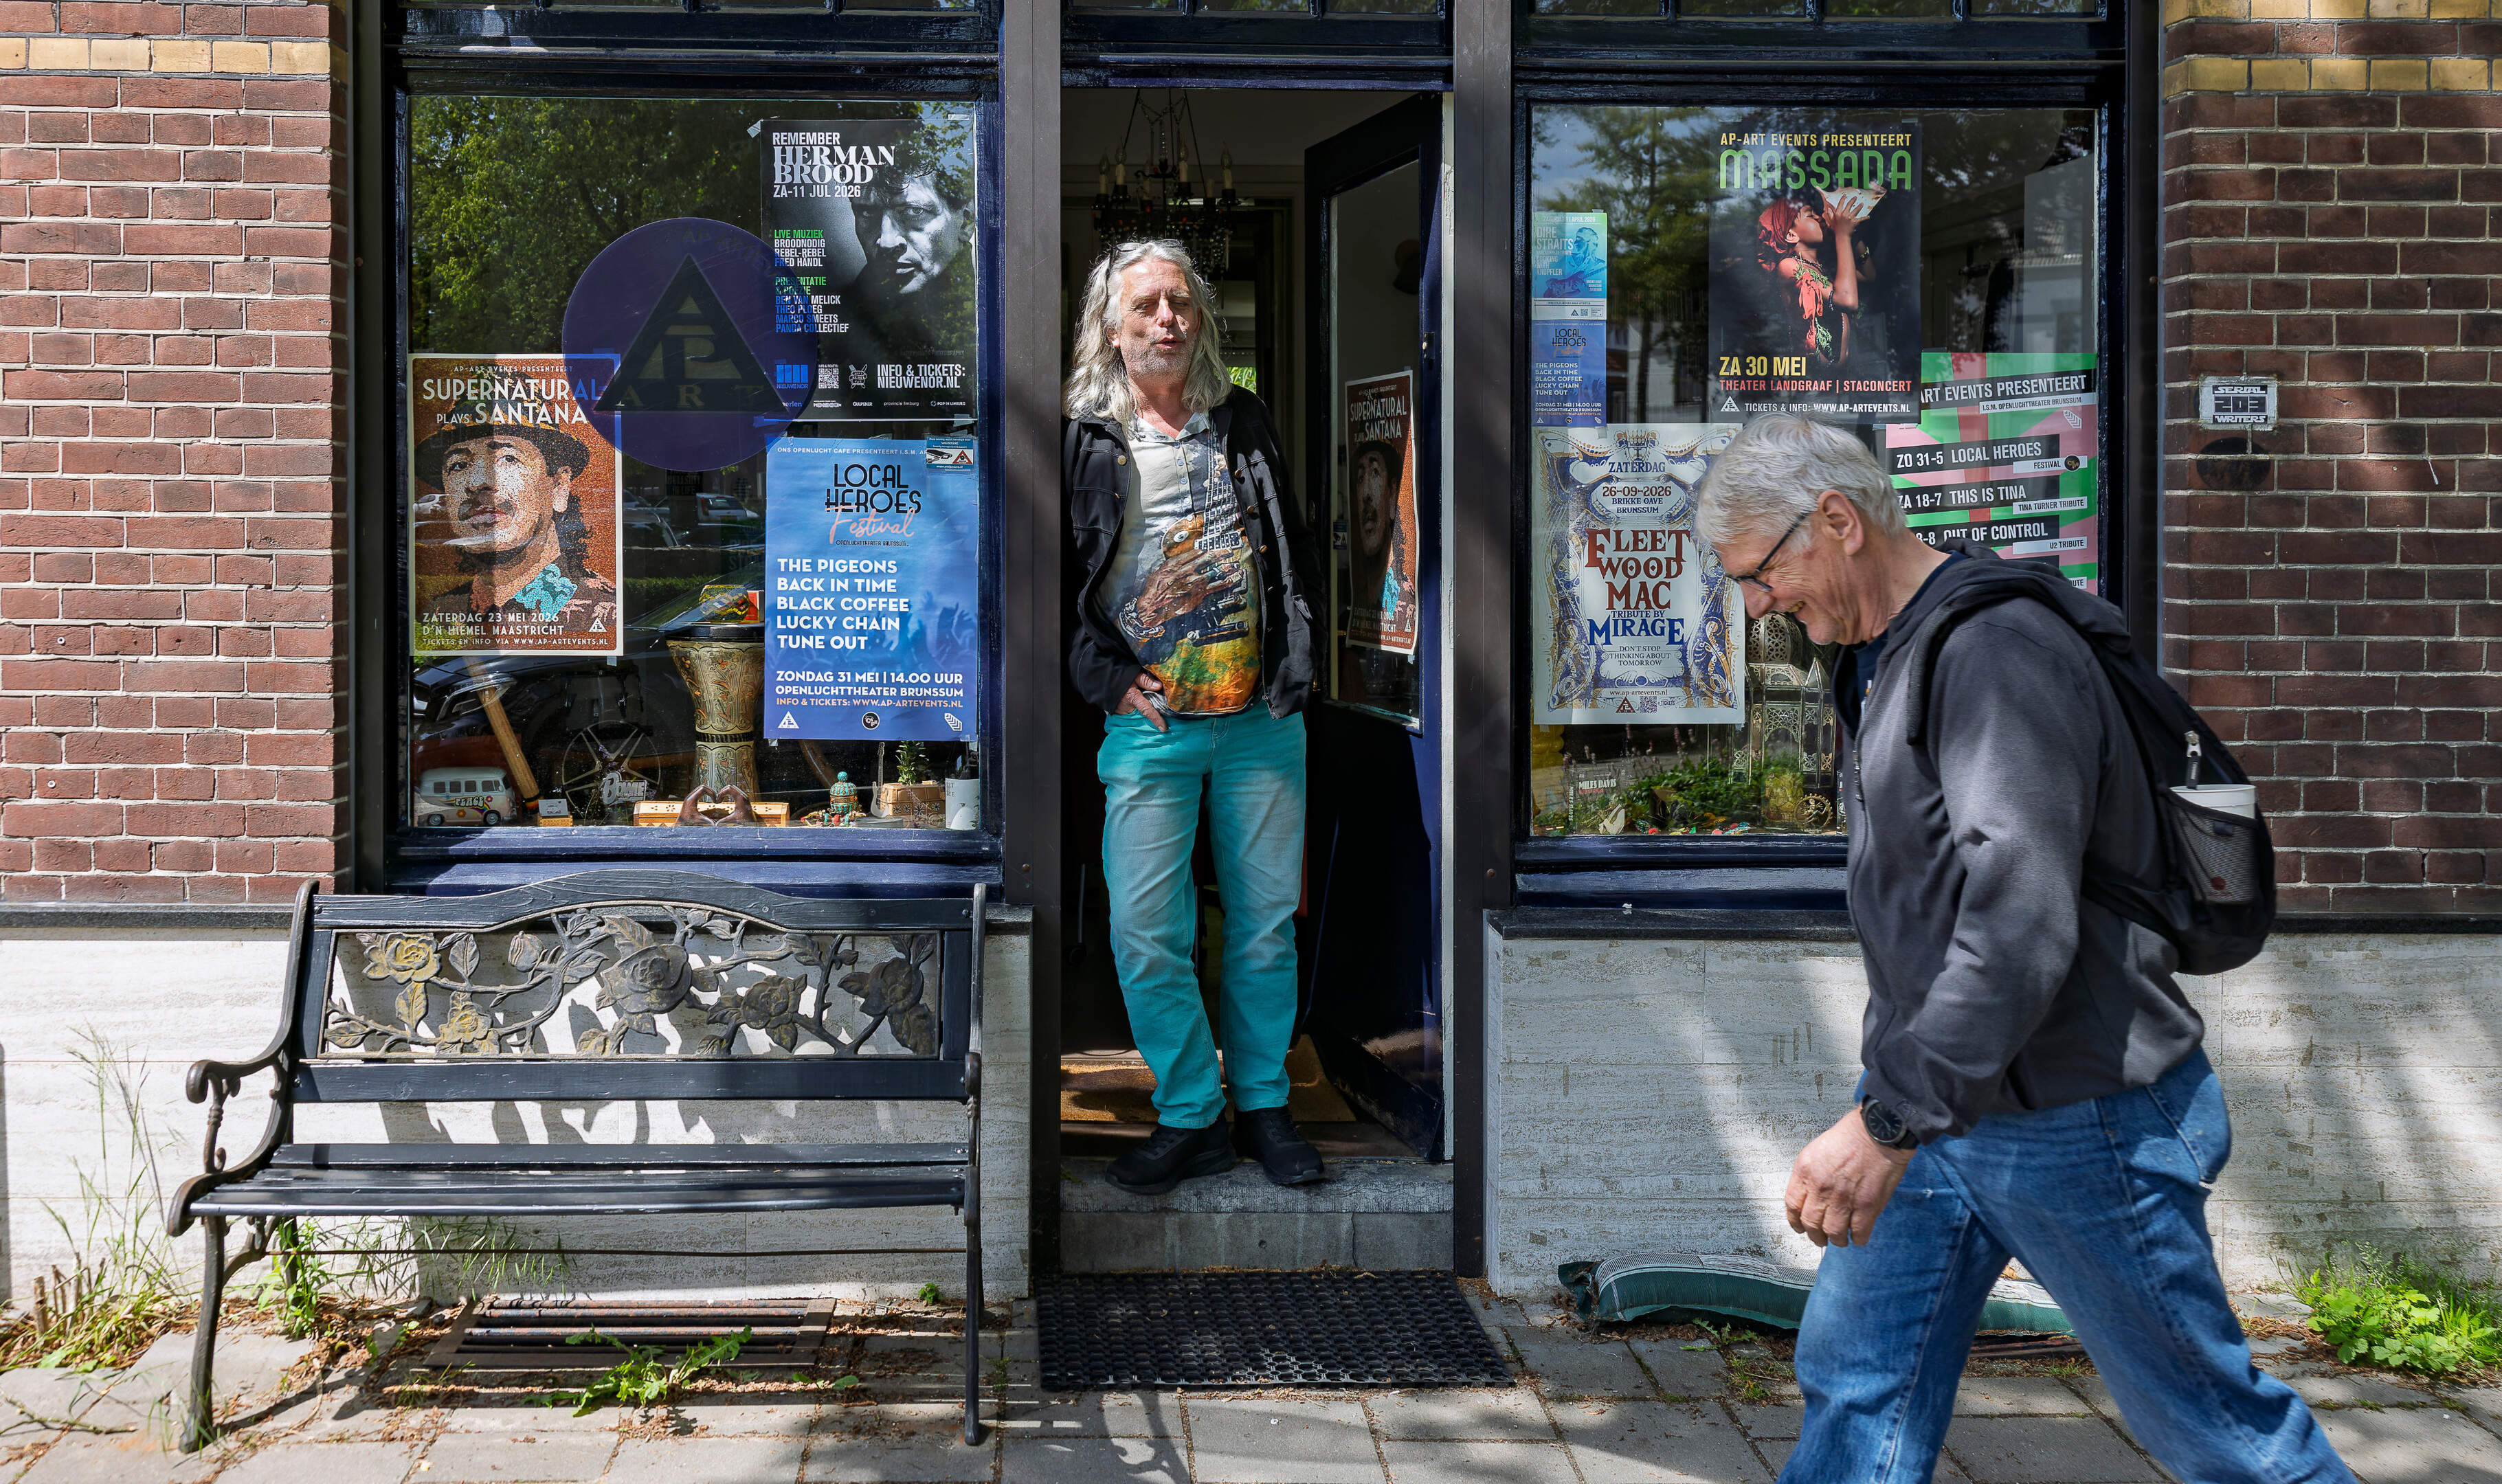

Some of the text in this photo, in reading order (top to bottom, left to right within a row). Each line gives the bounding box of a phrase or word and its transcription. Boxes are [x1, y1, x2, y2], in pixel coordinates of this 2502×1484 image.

[772, 133, 840, 145] REMEMBER
[1721, 133, 1912, 146] AP-ART EVENTS PRESENTEERT
[774, 145, 895, 166] HERMAN
[774, 164, 873, 183] BROOD
[1719, 149, 1912, 190] MASSADA
[774, 186, 861, 198] ZA-11 JUL 2026
[774, 229, 823, 238] LIVE MUZIEK
[1537, 227, 1556, 238] DIRE
[774, 239, 825, 247] BROODNODIG
[1537, 238, 1574, 250] STRAITS
[775, 248, 826, 257] REBEL-REBEL
[775, 258, 794, 267] FRED
[775, 277, 826, 285] PRESENTATIE
[776, 295, 840, 304] BEN VAN MELICK
[776, 305, 822, 314] THEO PLOEG
[776, 314, 838, 323] MARCO SMEETS
[776, 324, 849, 333] PANDA COLLECTIEF
[1555, 328, 1582, 337] LOCAL
[1552, 337, 1587, 347] HEROES
[878, 364, 965, 376] INFO & TICKETS:
[1719, 357, 1807, 376] ZA 30 MEI
[878, 376, 960, 388] NIEUWENOR.NL
[1719, 380, 1912, 392] THEATER LANDGRAAF STACONCERT
[1945, 375, 2086, 401] EVENTS PRESENTEERT
[423, 379, 601, 401] SUPERNATURAL
[1745, 403, 1910, 412] TICKETS & INFO: WWW.AP-ARTEVENTS.NL
[1998, 399, 2051, 409] OPENLUCHTTHEATER
[2052, 396, 2082, 405] BRUNSSUM
[437, 403, 588, 425] PLAYS SANTANA
[1350, 395, 1407, 423] SUPERNATURAL
[1365, 418, 1402, 440] SANTANA
[1897, 442, 2042, 469] ZO 31-5 LOCAL HEROES
[1608, 462, 1666, 473] ZATERDAG
[2034, 460, 2061, 469] FESTIVAL
[834, 463, 909, 488] LOCAL
[1602, 486, 1672, 497] 26-09-2026
[1915, 492, 1942, 508] 18-7
[1949, 489, 1978, 505] THIS
[1981, 488, 1993, 502] IS
[1997, 484, 2026, 502] TINA
[825, 488, 922, 514] HEROES
[2018, 499, 2084, 512] TINA TURNER TRIBUTE
[825, 506, 915, 544] Festival
[1972, 527, 1987, 541] OF
[1991, 522, 2048, 539] CONTROL
[1585, 528, 1690, 568] FLEET
[2050, 539, 2084, 549] U2 TRIBUTE
[777, 559, 897, 574] THE PIGEONS
[1598, 556, 1684, 579] WOOD
[777, 577, 897, 592] BACK IN TIME
[1605, 578, 1671, 610] MAC
[777, 596, 909, 611] BLACK COFFEE
[423, 612, 559, 622] ZATERDAG 23 MEI 2026
[1611, 610, 1665, 618] TRIBUTE BY
[777, 615, 900, 631] LUCKY CHAIN
[448, 625, 487, 636] HIEMEL
[493, 625, 564, 636] MAASTRICHT
[1587, 615, 1684, 646] MIRAGE
[777, 635, 868, 649] TUNE OUT
[777, 671, 963, 684] ZONDAG 31 MEI 14.00 UUR
[776, 686, 963, 697] OPENLUCHTTHEATER BRUNSSUM
[777, 697, 799, 706] INFO
[809, 698, 851, 706] TICKETS:
[852, 699, 963, 708] WWW.AP-ARTEVENTS.NL
[1579, 778, 1617, 789] MILES DAVIS
[454, 796, 484, 808] PEACE
